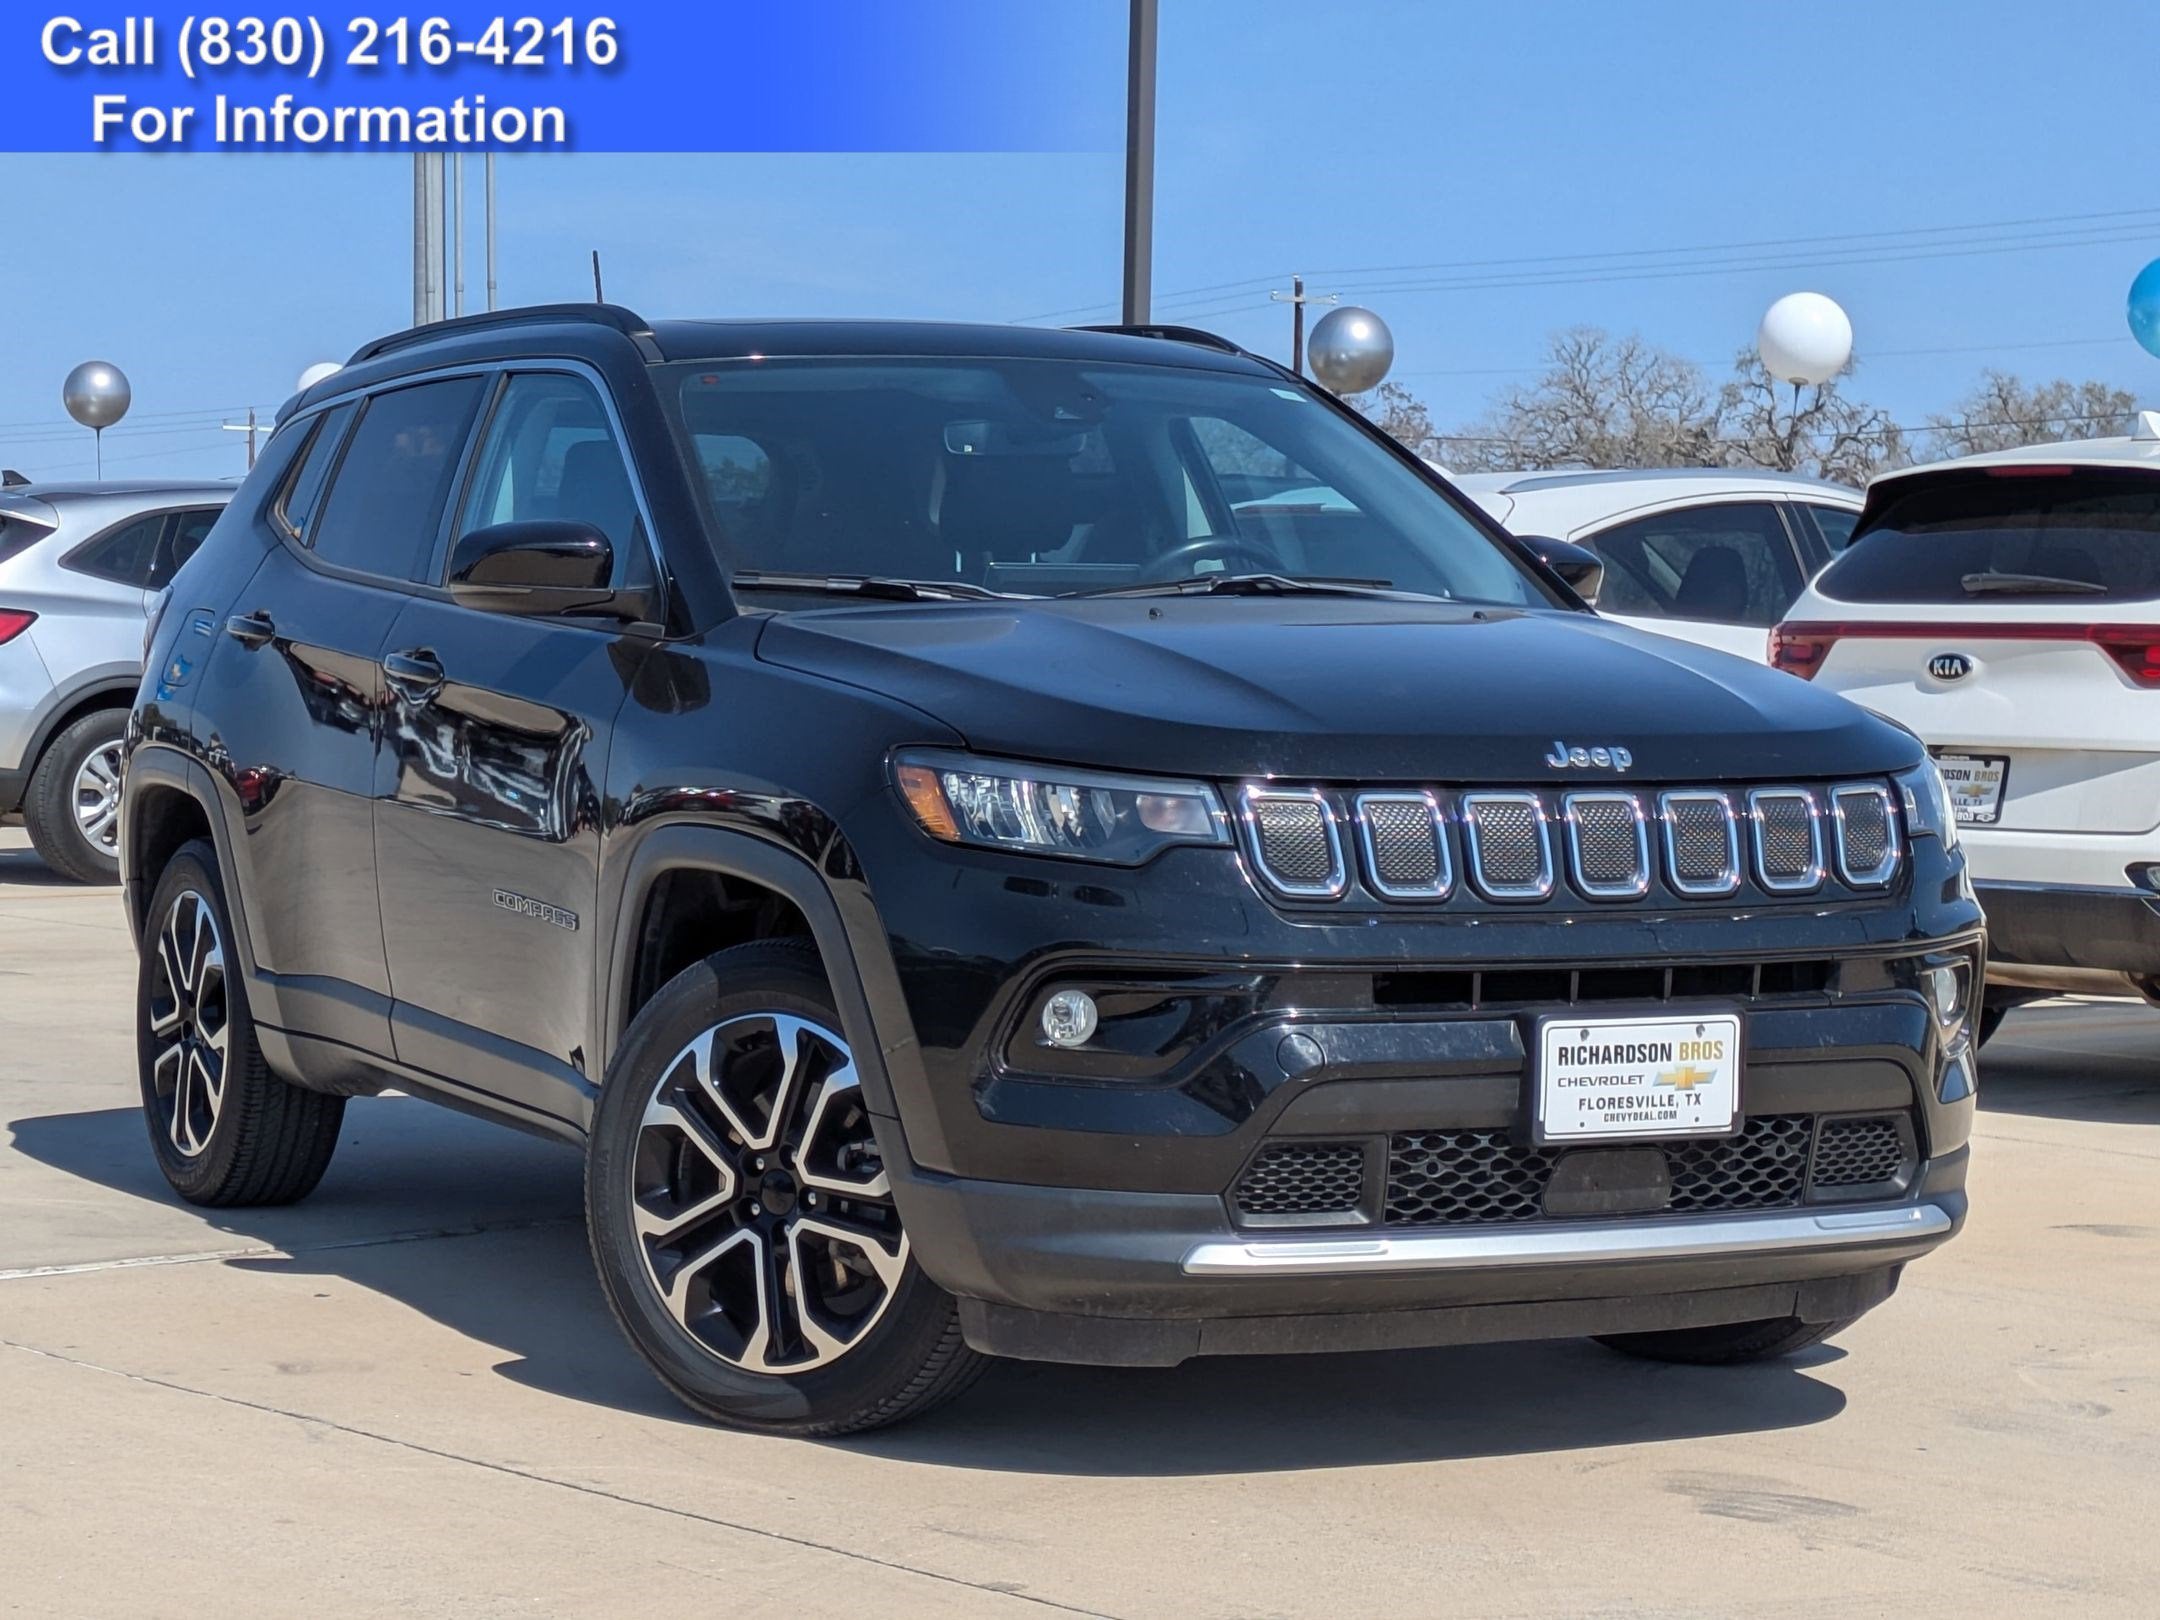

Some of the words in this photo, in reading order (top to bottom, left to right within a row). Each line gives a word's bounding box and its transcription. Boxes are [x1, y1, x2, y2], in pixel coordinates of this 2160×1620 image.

[1933, 659, 1963, 675] KIA
[1545, 741, 1633, 772] Jeep
[1974, 770, 2000, 782] BROS
[493, 889, 578, 931] COMPASS
[1558, 1043, 1672, 1066] RICHARDSON
[1679, 1041, 1724, 1061] BROS
[1557, 1074, 1645, 1087] CHEVROLET
[1578, 1094, 1679, 1111] FLORESVILLE,
[1685, 1093, 1702, 1106] TX
[1603, 1110, 1677, 1123] CHEVYDEAL.COM
